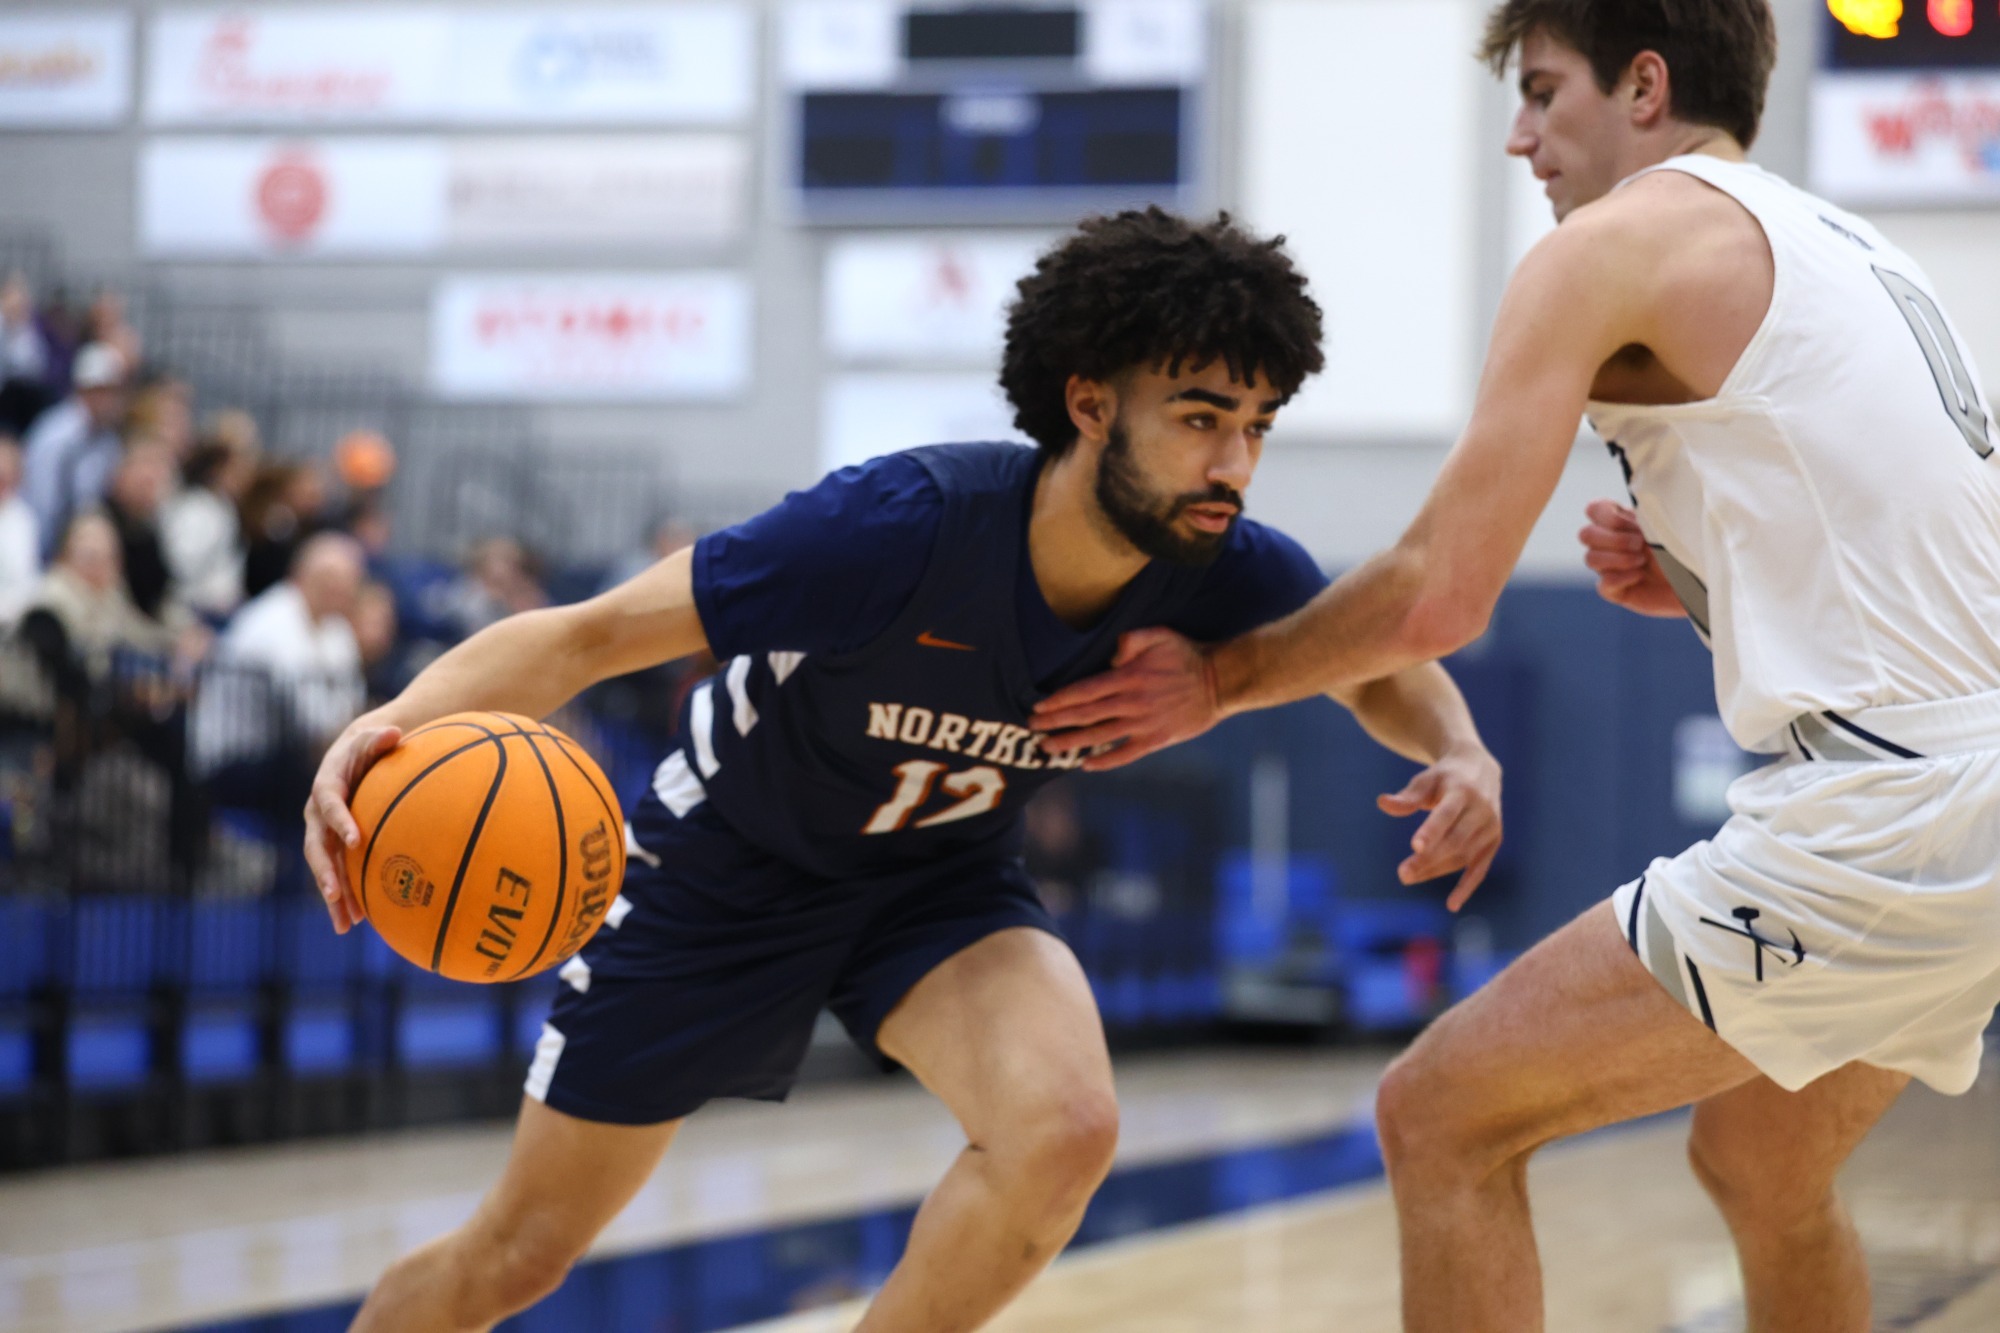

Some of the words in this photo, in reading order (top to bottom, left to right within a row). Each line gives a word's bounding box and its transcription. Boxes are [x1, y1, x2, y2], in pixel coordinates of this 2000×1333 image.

[861, 759, 1007, 835] 12
[475, 866, 532, 961] EVO
[544, 820, 612, 967] Wilso
